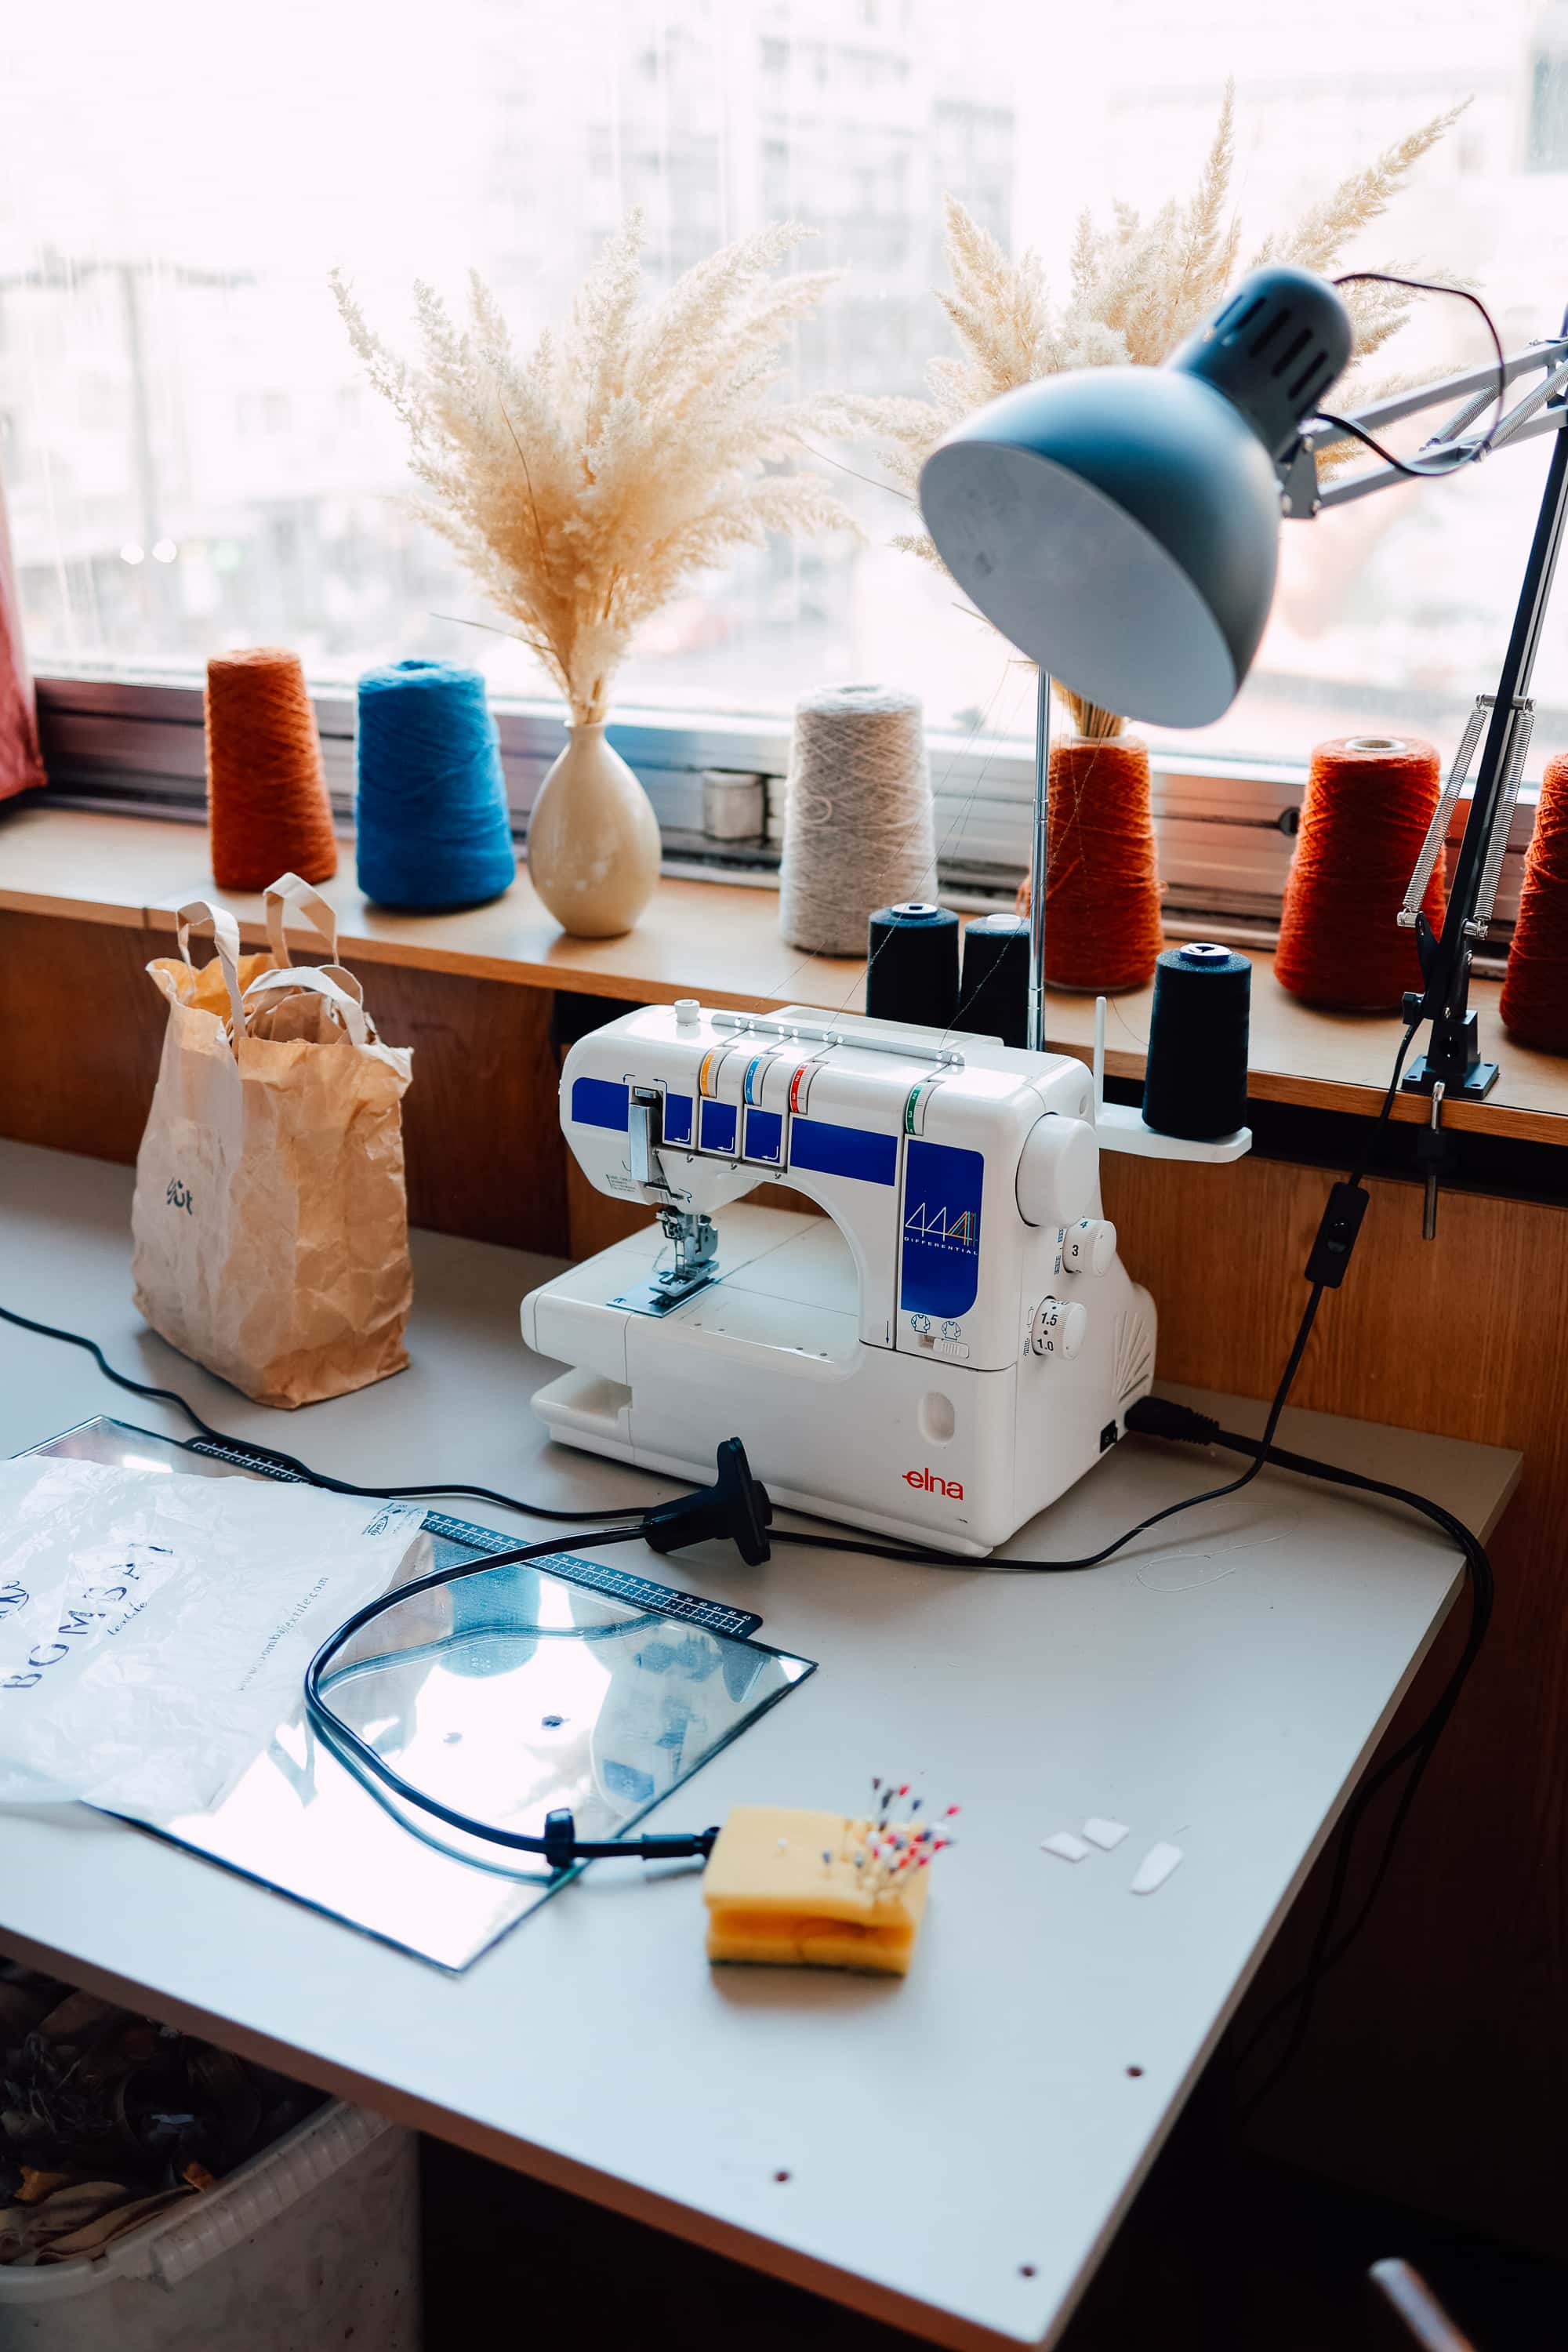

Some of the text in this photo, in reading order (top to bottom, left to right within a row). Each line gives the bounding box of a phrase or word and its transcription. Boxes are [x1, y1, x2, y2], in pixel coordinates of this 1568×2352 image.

[903, 1236, 978, 1256] DIFFERENTIAL
[1072, 1244, 1080, 1257] 3
[1041, 1312, 1058, 1327] 1.5
[1036, 1338, 1054, 1352] 1.0
[902, 1467, 964, 1501] elna
